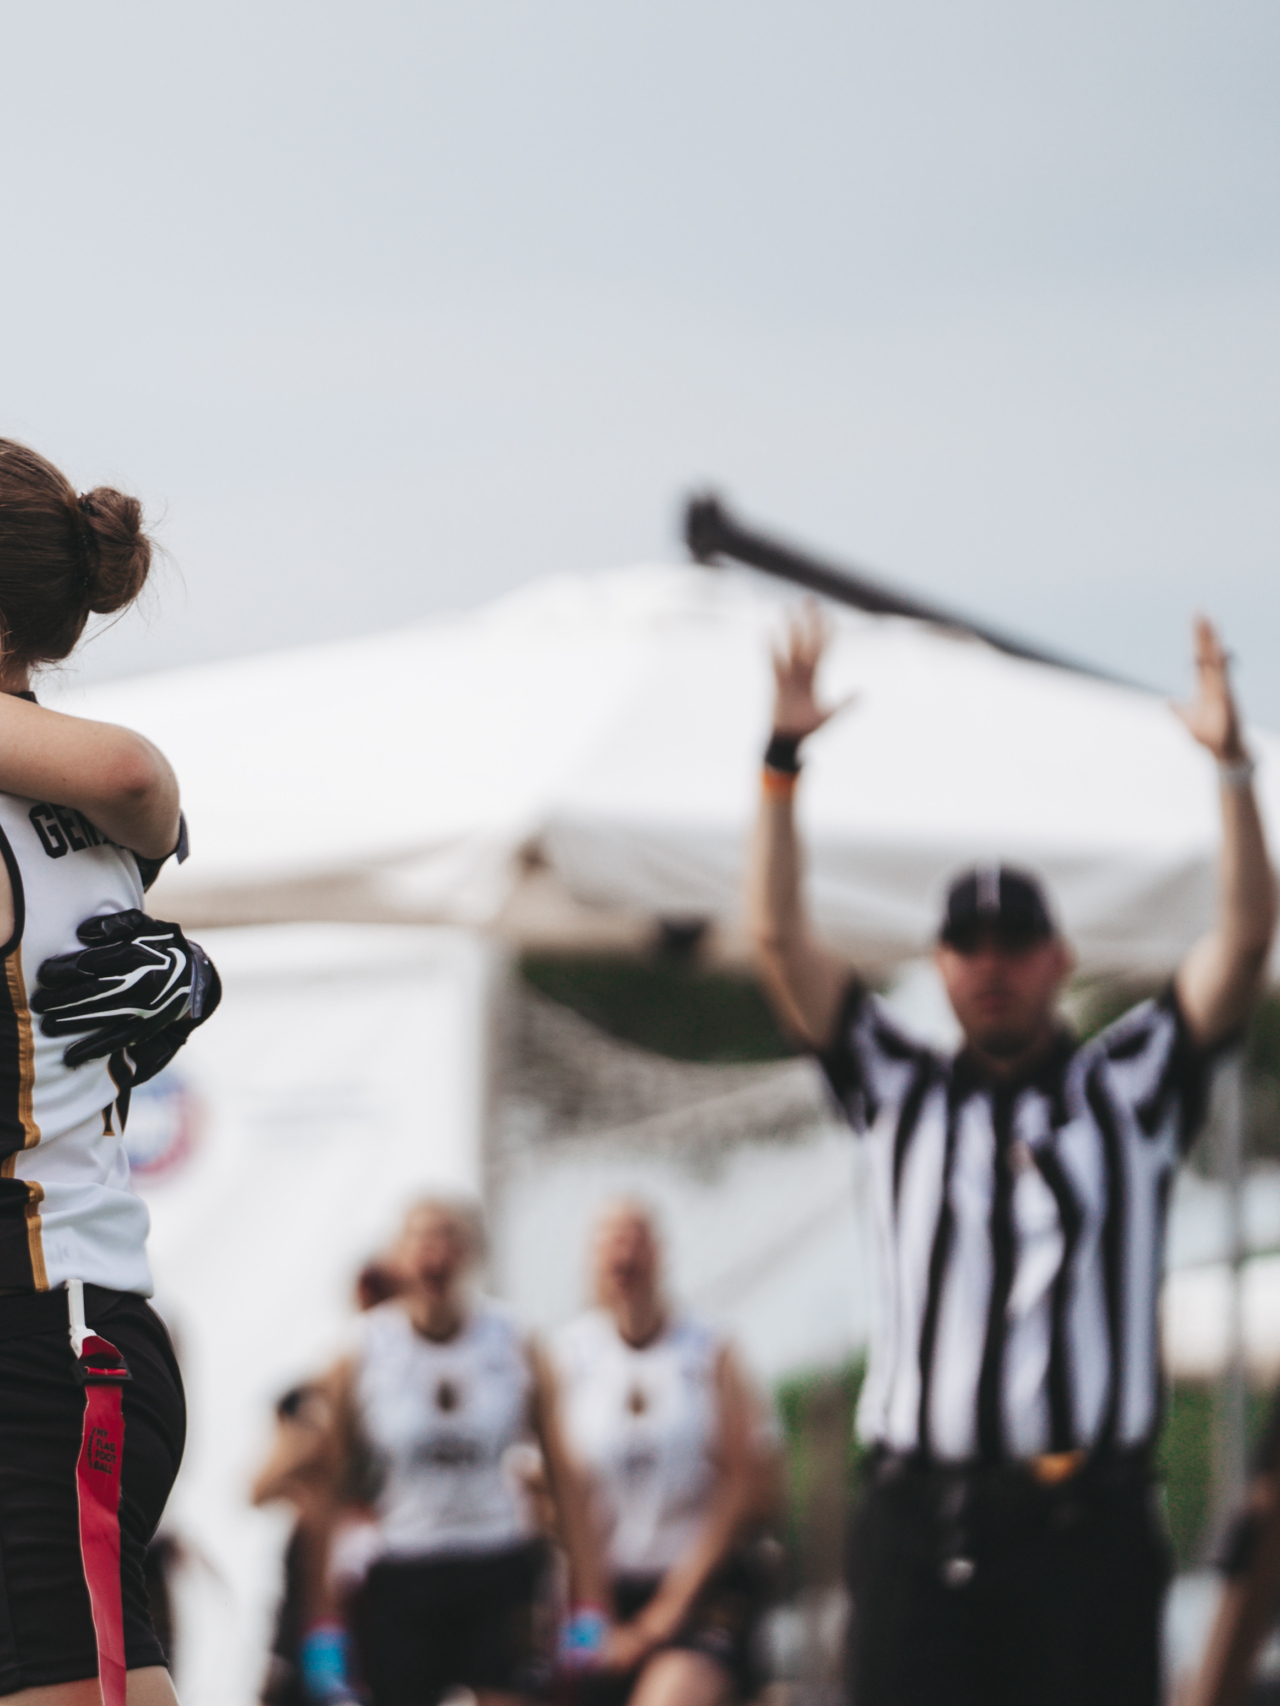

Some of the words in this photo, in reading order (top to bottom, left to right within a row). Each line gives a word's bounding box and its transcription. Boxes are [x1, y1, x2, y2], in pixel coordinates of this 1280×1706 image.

[96, 1427, 109, 1439] MY
[96, 1438, 116, 1453] FLAG
[95, 1449, 117, 1465] FOOT
[93, 1460, 113, 1475] BALL
